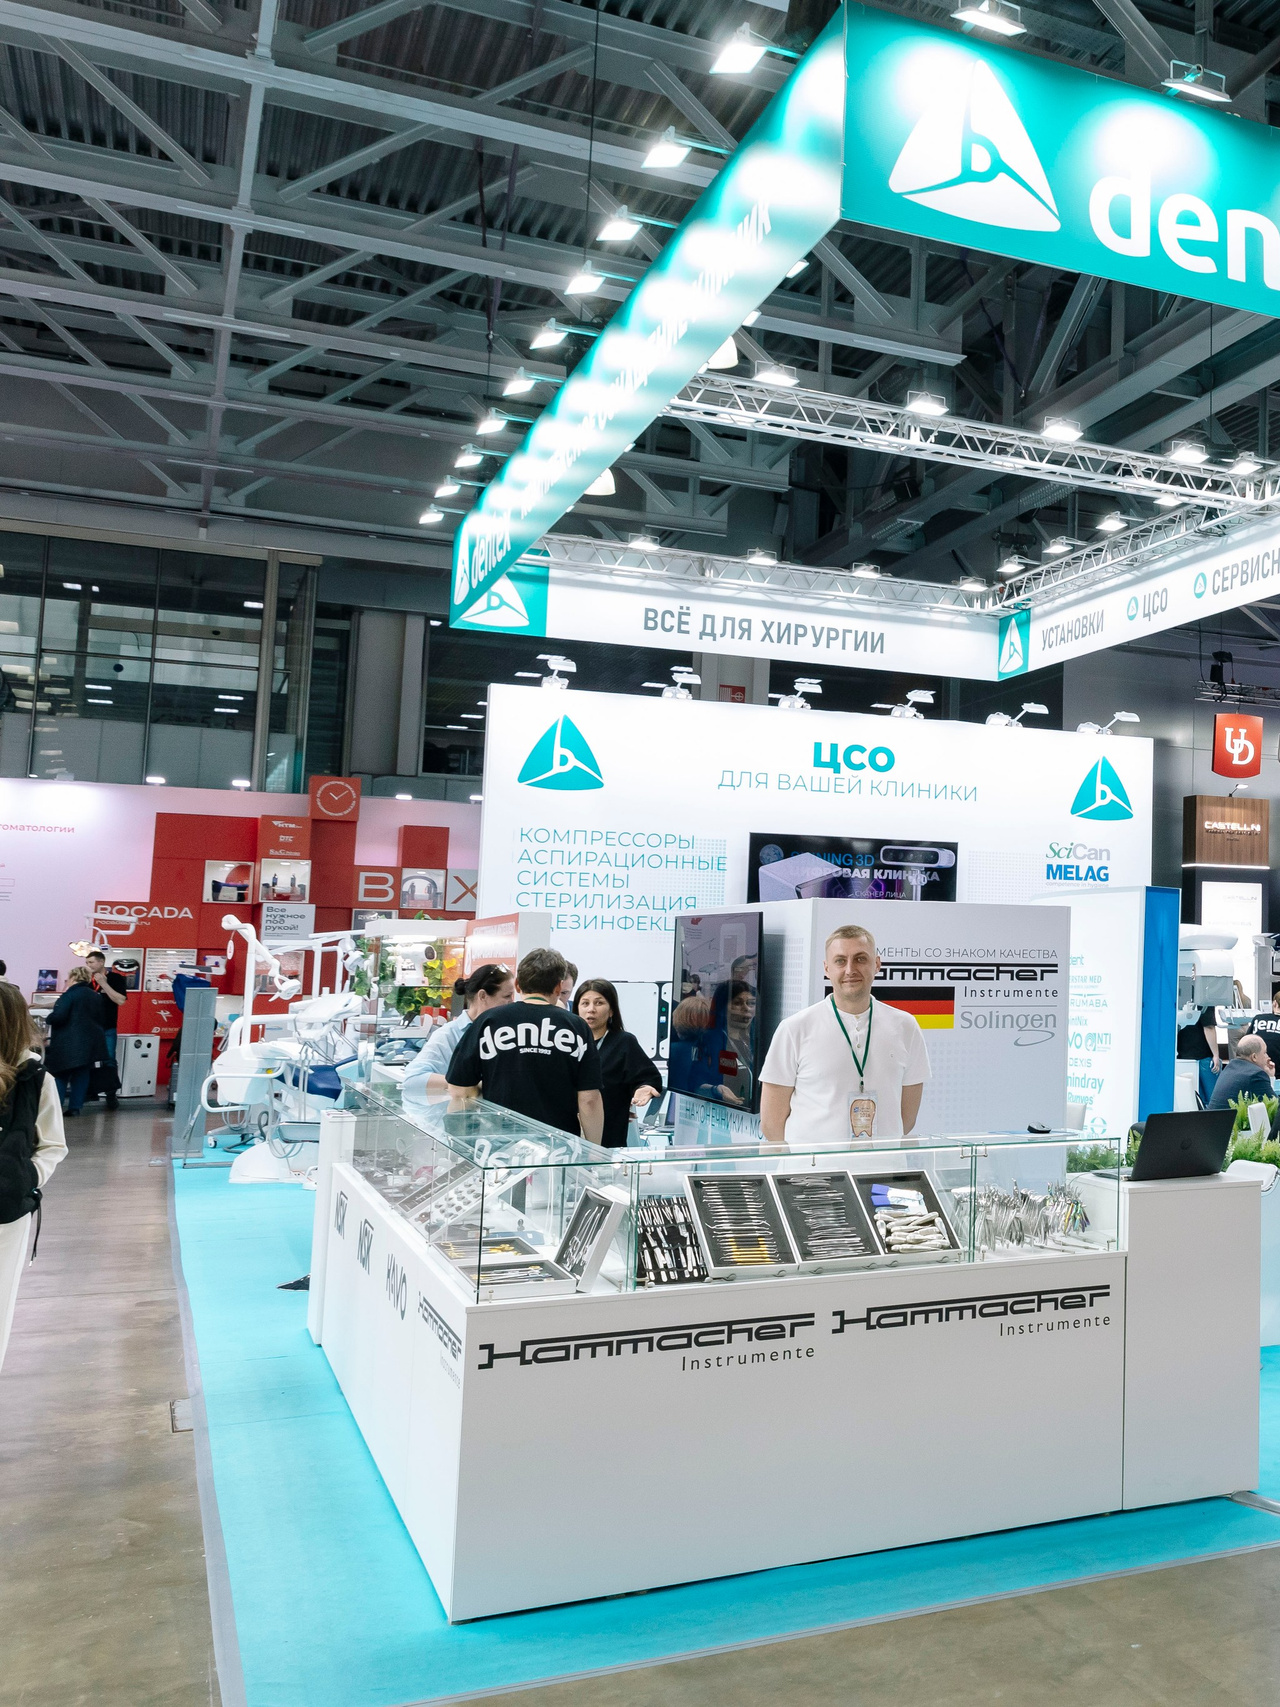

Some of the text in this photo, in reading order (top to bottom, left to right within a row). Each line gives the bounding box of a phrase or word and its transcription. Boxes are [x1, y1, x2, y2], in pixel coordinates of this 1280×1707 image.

[1142, 588, 1169, 621] ЦСО
[643, 606, 885, 654] ВСЁ ДЛЯ ХИРУРГИИ
[1042, 609, 1105, 651] УСТАНОВКИ
[813, 741, 895, 775] ЦСО
[718, 770, 978, 802] ДЛЯ ВАШЕЙ КЛИНИКИ
[520, 827, 695, 850] КОМПРЕССОРЫ
[517, 849, 728, 872] АСПИРАЦИОННЫЕ
[855, 854, 875, 867] 3D
[1045, 841, 1111, 861] SciCan
[516, 870, 629, 889] СИСТЕМЫ
[874, 869, 940, 882] КЛИНКА
[1046, 864, 1109, 882] MELAG
[515, 891, 697, 912] СТЕРИЛИЗАЦИЯ
[855, 890, 907, 899] СКАНЕР ЛИЦА
[96, 904, 194, 919] ROCADA
[265, 912, 306, 920] нужное
[265, 924, 299, 932] рукой!
[551, 914, 675, 933] ЕЗИНФЕКЦ
[876, 947, 1058, 959] МЕНТЫ СО ЗНАКОМ КАЧЕСТВА
[873, 961, 1058, 981] mmacher
[1089, 975, 1102, 984] MED
[964, 985, 1058, 998] Instrumente
[1069, 998, 1108, 1008] RUMABA
[960, 1010, 1057, 1046] Solingen
[479, 1017, 588, 1062] dentex
[1068, 1032, 1112, 1050] VO NTI
[1069, 1057, 1092, 1068] DEXIS
[686, 1100, 744, 1134] НАКОНЕЧНИКИ
[478, 1284, 1110, 1371] Hammacher Hammacher
[681, 1315, 1111, 1372] Instrumente Instrumente
